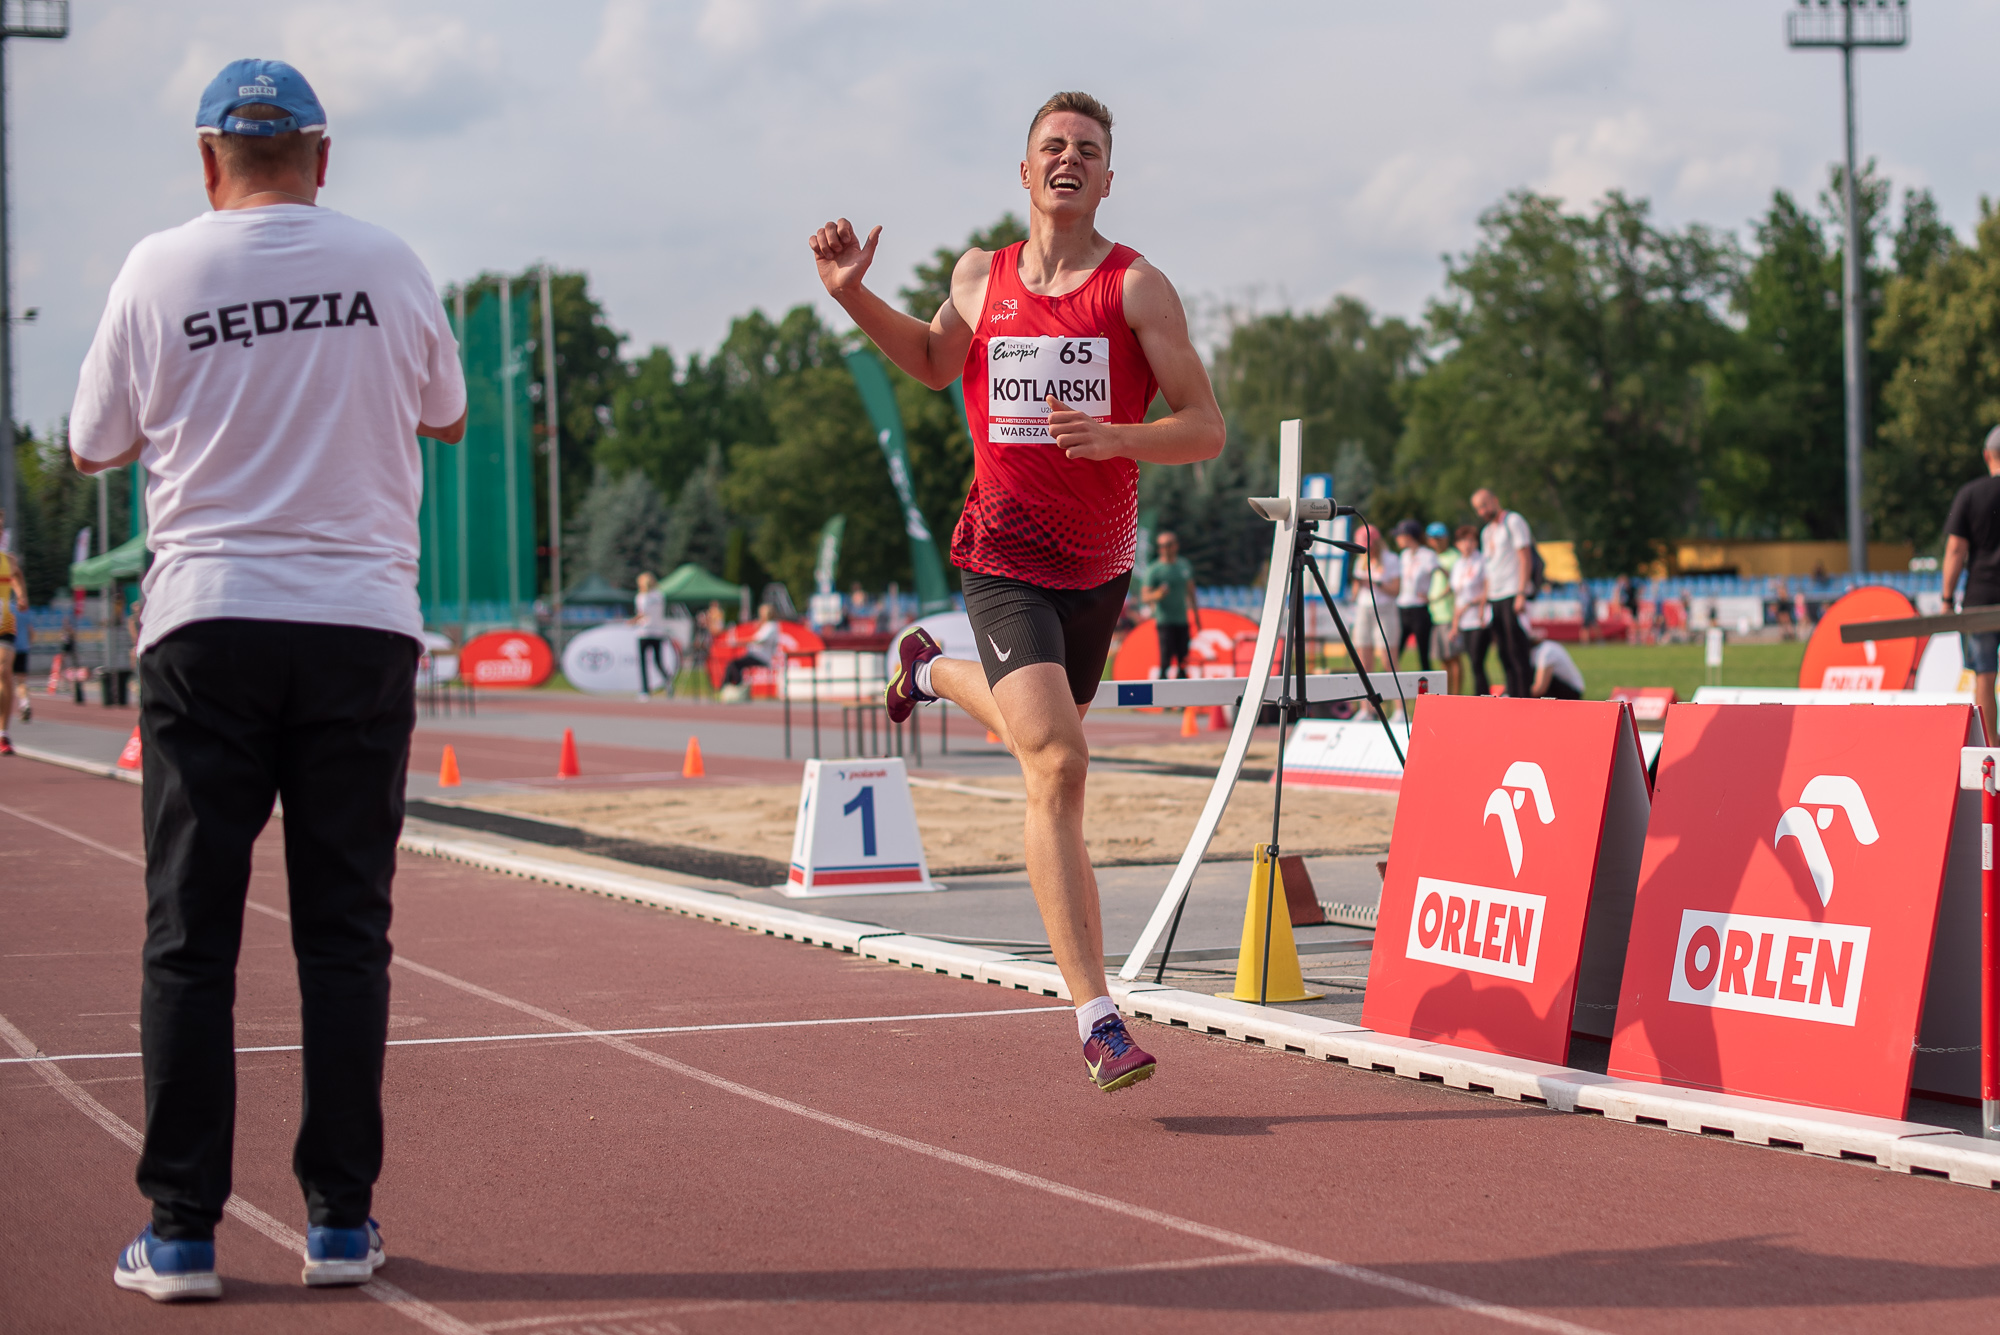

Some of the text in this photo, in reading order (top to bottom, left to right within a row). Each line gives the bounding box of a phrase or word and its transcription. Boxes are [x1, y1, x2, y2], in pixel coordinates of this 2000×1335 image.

[241, 87, 274, 95] ORLEN
[183, 291, 379, 351] SĘDZIA
[993, 341, 1040, 363] Europol
[1059, 341, 1093, 365] 65
[993, 378, 1106, 402] KOTLARSKI
[1000, 426, 1050, 437] WARSZA
[843, 785, 878, 857] 1
[1417, 890, 1535, 968] ORLEN
[1684, 923, 1854, 1008] ORLEN
